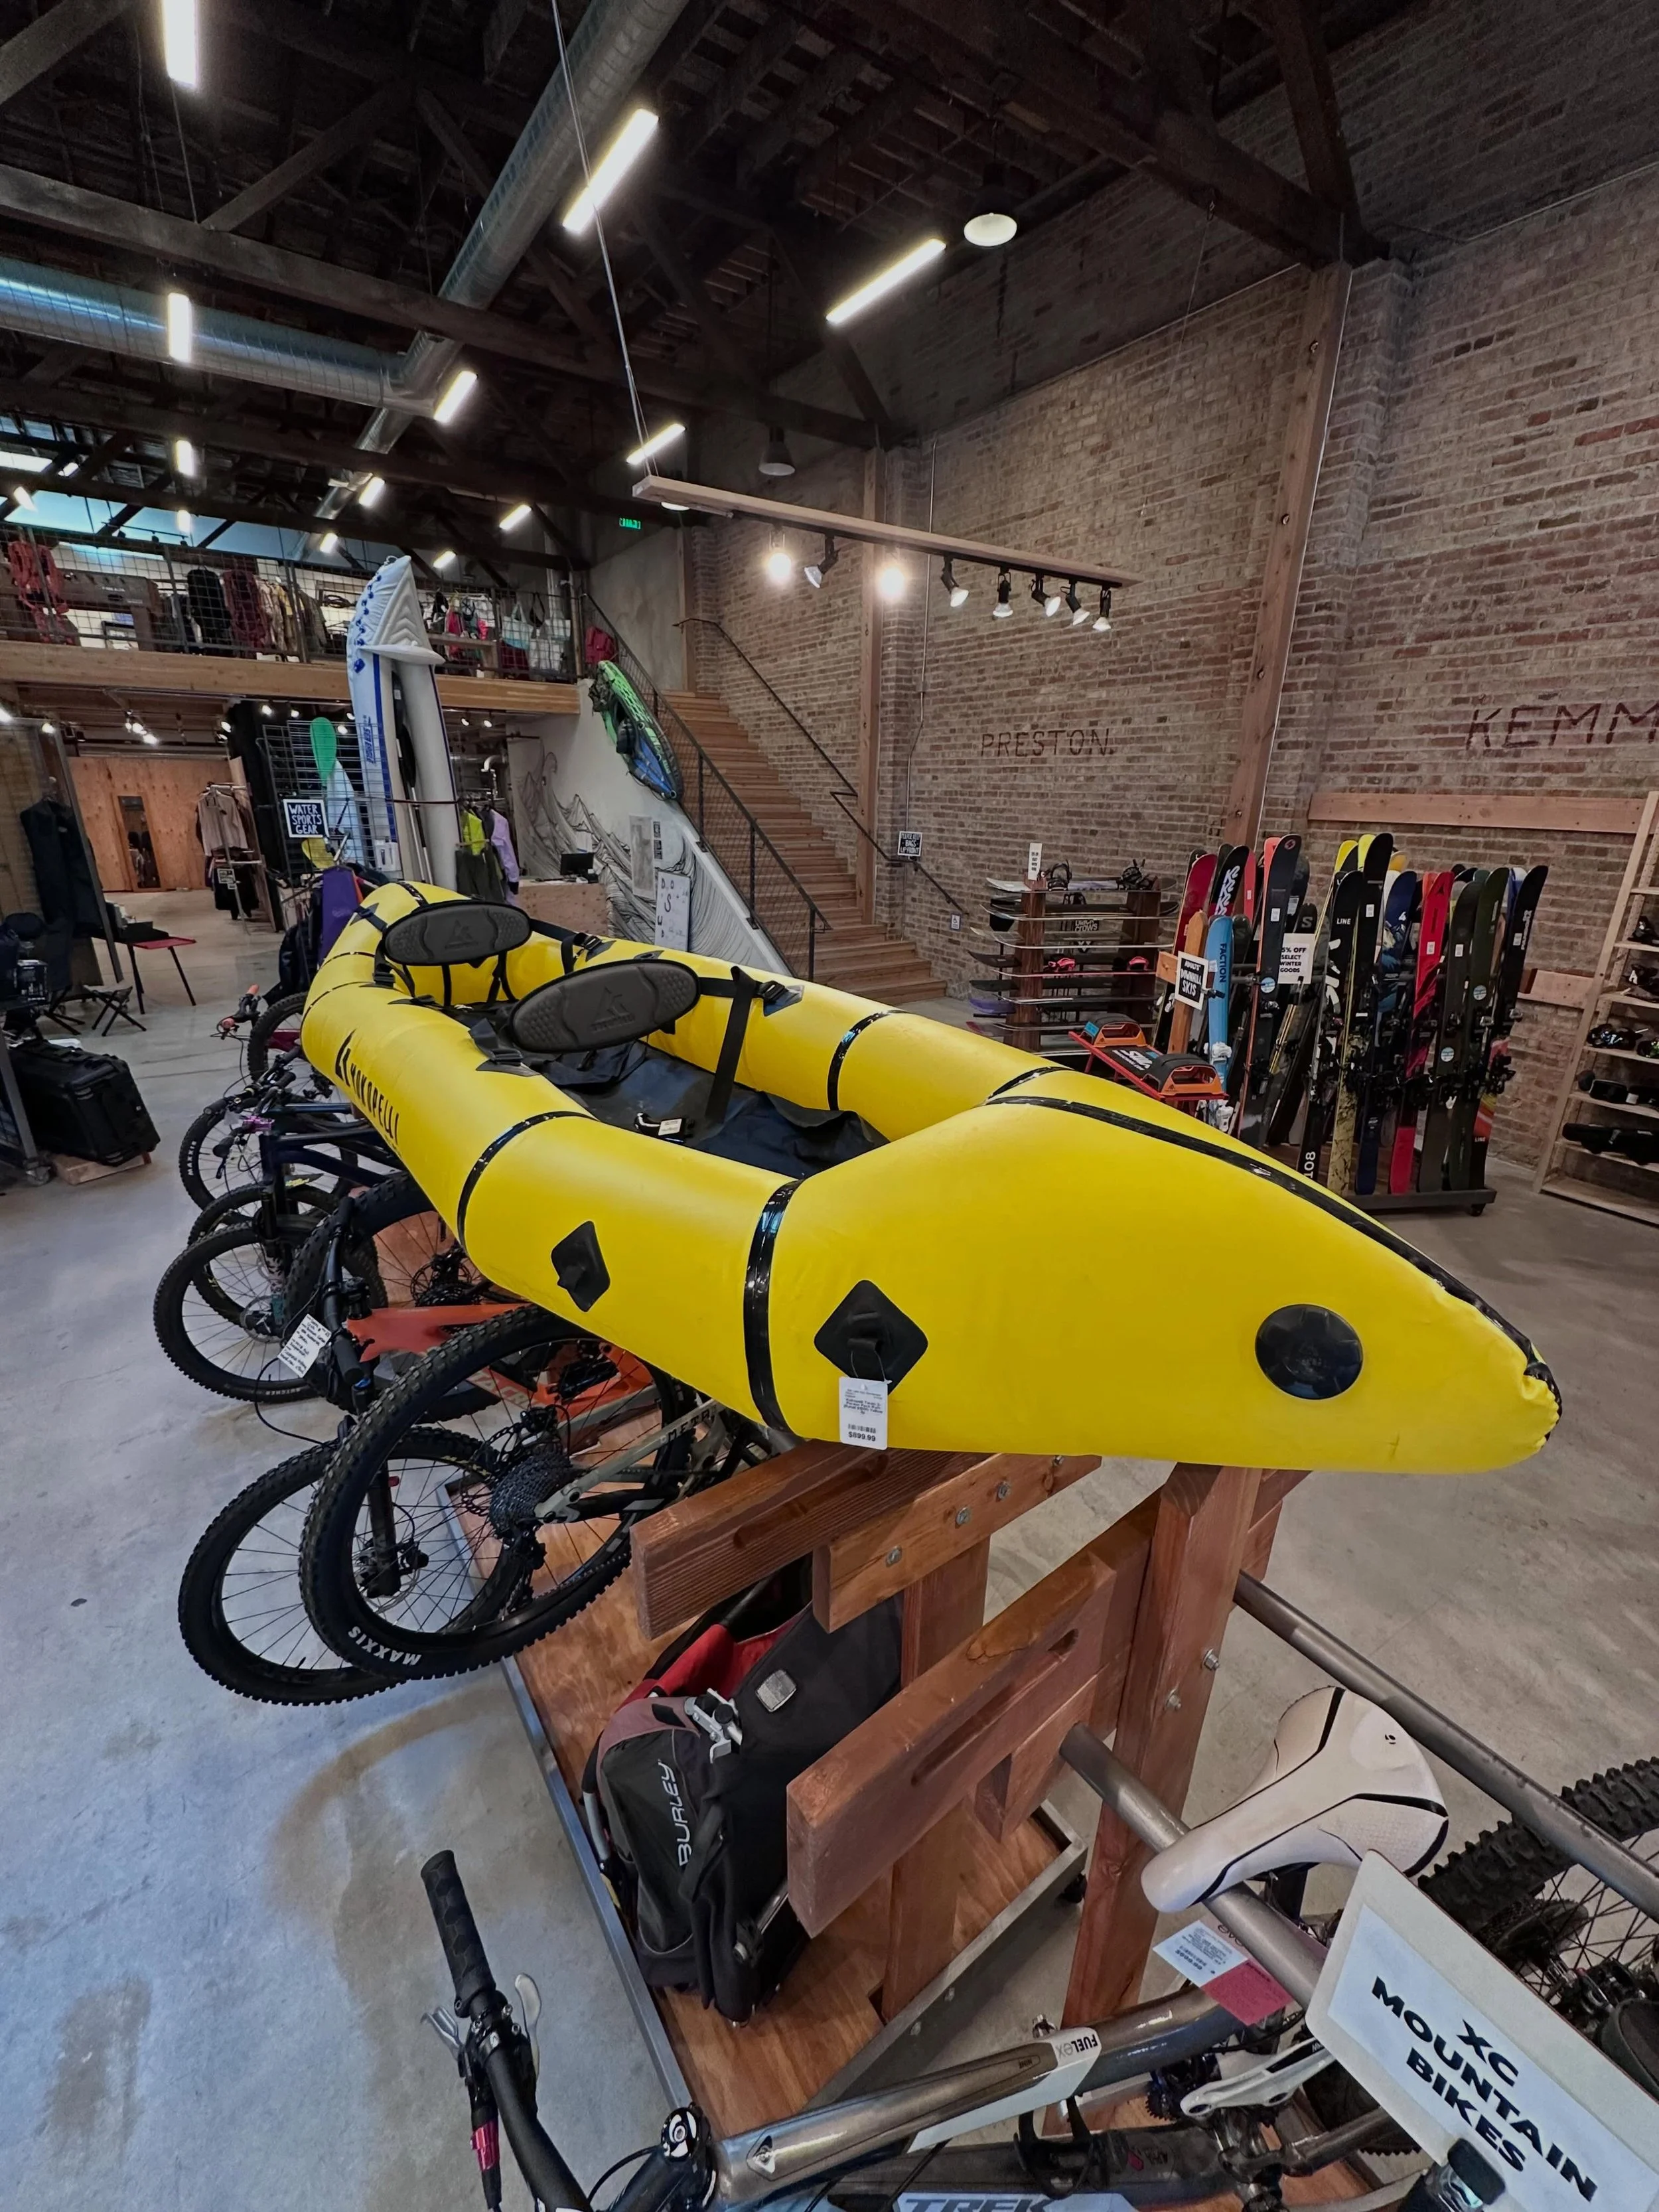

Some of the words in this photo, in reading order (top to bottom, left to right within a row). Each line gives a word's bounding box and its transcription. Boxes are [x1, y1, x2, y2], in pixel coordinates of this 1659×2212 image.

[288, 804, 318, 814] WATER
[291, 814, 323, 825] SPORTS
[295, 824, 319, 834] GEAR
[1182, 980, 1197, 997] SKIS
[350, 1063, 399, 1147] KOKOPELLI
[186, 1141, 196, 1176] MAXXIS
[1304, 1151, 1316, 1179] 108
[848, 1432, 876, 1441] $899.99
[348, 1626, 422, 1666] MAXXIS
[658, 1761, 692, 1867] BURLEY
[1456, 2019, 1520, 2087] XC
[1371, 1975, 1599, 2203] MOUNTAIN
[1406, 2047, 1526, 2172] BIKES
